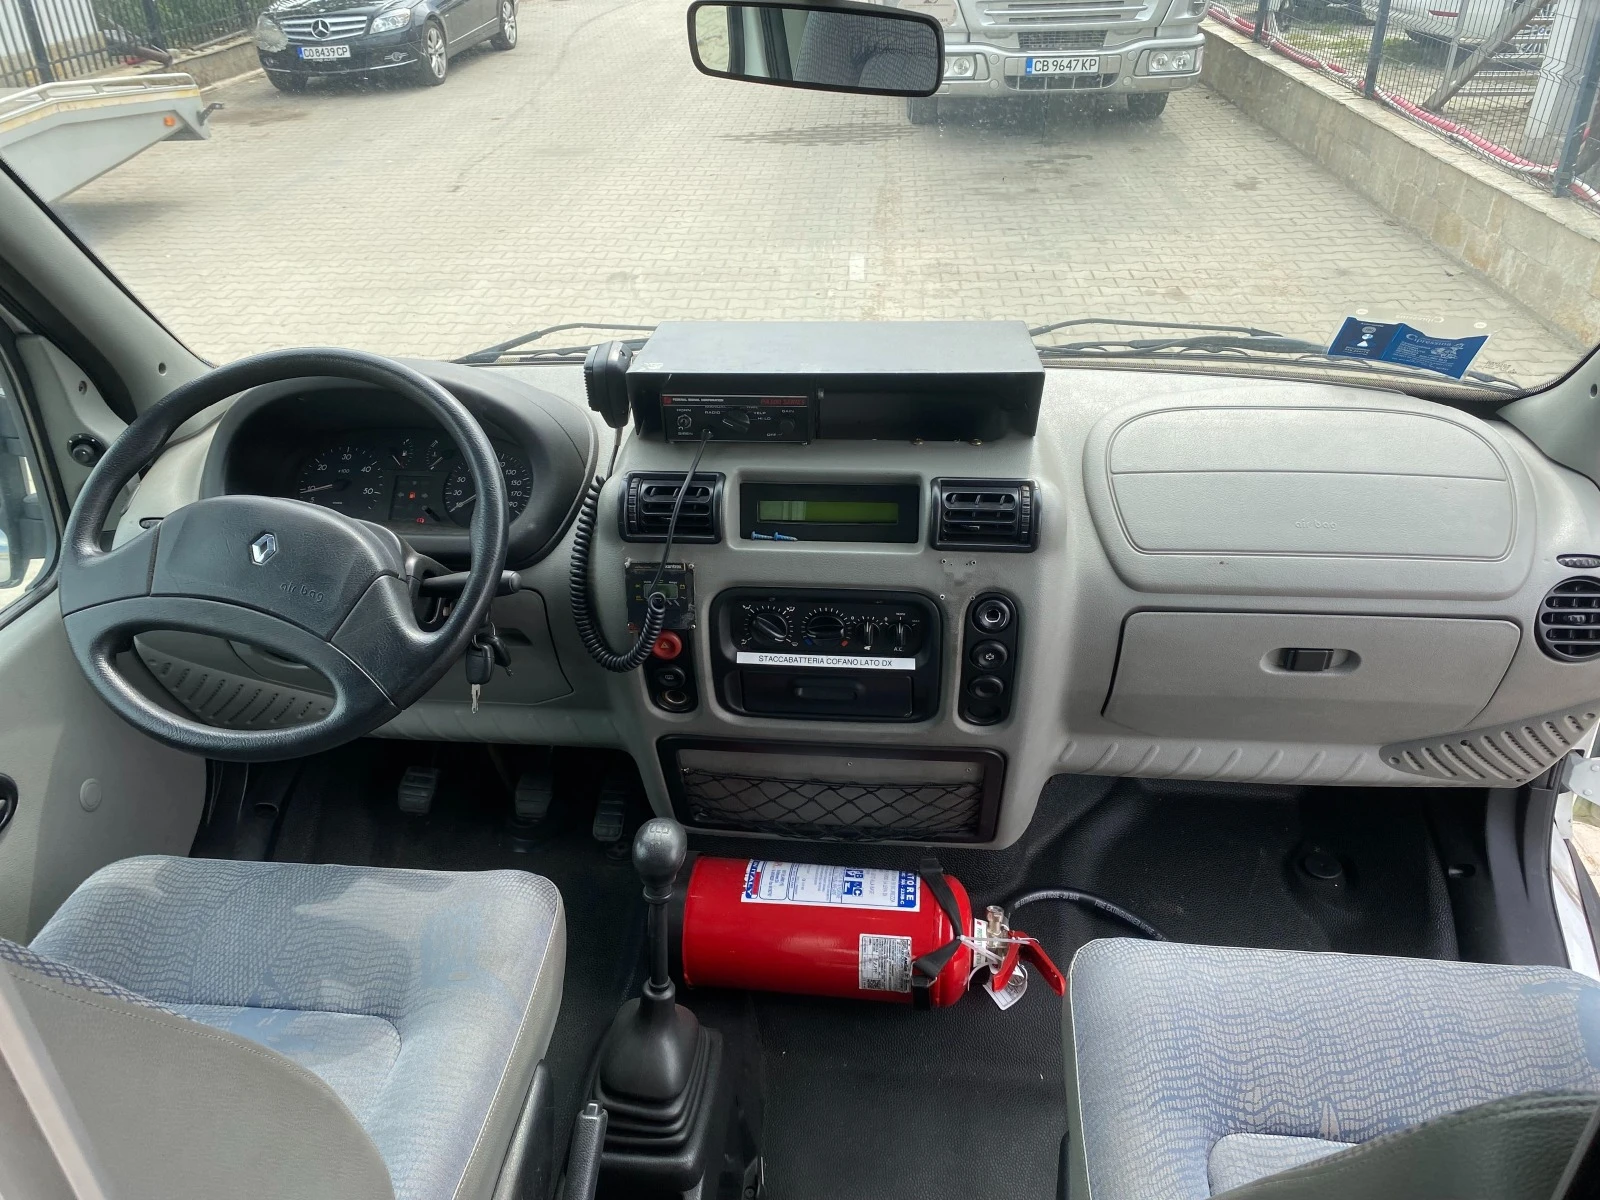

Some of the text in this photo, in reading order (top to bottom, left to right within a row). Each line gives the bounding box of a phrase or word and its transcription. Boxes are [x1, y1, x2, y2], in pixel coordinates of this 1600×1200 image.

[315, 47, 336, 58] 8439
[336, 46, 348, 56] CP
[1034, 58, 1097, 72] CB 9647 KP
[341, 453, 352, 461] 30
[360, 465, 372, 473] 40
[362, 487, 374, 495] 50
[1295, 518, 1338, 532] air bag
[279, 580, 325, 603] air bag
[758, 654, 893, 667] STACCABATTERIA COFANO LATO DX
[747, 868, 756, 896] ITALY
[853, 888, 863, 897] C
[1068, 892, 1080, 901] BAR
[1094, 899, 1107, 910] FIRE
[1105, 903, 1142, 927] EXTINGUISHER
